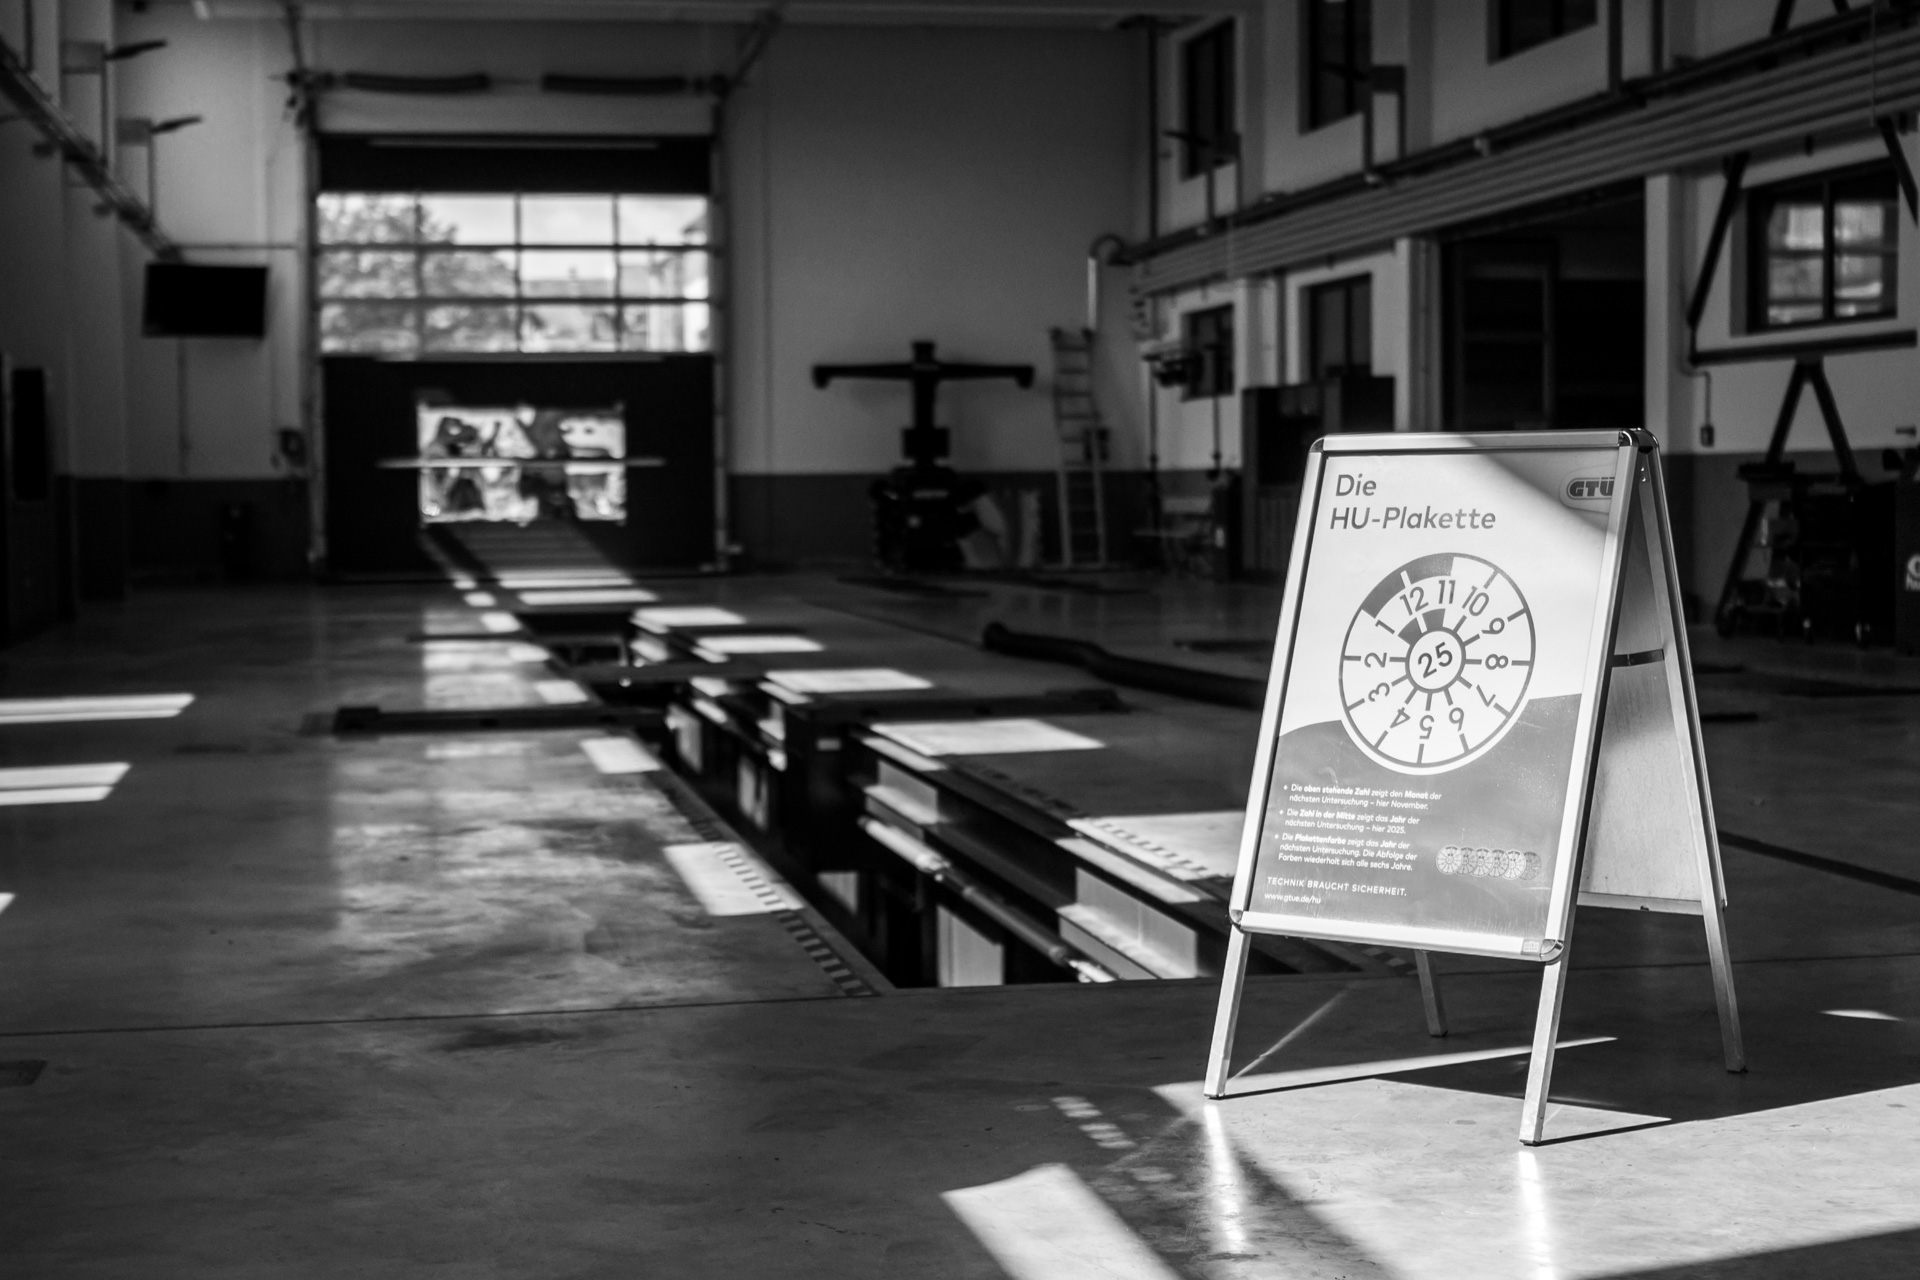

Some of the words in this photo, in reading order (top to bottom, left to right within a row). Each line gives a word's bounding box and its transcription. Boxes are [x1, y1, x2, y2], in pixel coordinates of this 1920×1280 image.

[1335, 473, 1376, 496] Die
[1330, 506, 1496, 530] HU-Plakette
[1399, 586, 1429, 615] 12
[1438, 580, 1456, 604] 11
[1462, 585, 1489, 616] 10
[1375, 619, 1395, 635] 1
[1482, 617, 1505, 635] 9
[1364, 652, 1387, 668] 2
[1418, 642, 1453, 678] 25
[1485, 654, 1508, 670] 8
[1368, 682, 1390, 702] 3
[1476, 684, 1496, 707] 7
[1390, 707, 1411, 728] 4
[1449, 707, 1465, 732] 6
[1419, 715, 1434, 739] 5
[1322, 796, 1368, 807] Untersuchung
[1391, 800, 1428, 809] November.
[1354, 788, 1370, 796] Zahl
[1371, 789, 1388, 798] zeigt
[1405, 790, 1428, 799] Monat
[1317, 821, 1364, 832] Untersuchung
[1387, 826, 1406, 834] 2025.
[1357, 814, 1374, 822] zeigt
[1390, 815, 1406, 823] Jahr
[1295, 834, 1346, 844] Plakettenfarbe
[1347, 838, 1364, 847] zeigt
[1380, 840, 1397, 848] Jahr
[1280, 844, 1310, 852] nächsten
[1312, 846, 1360, 857] Untersuchung.
[1376, 850, 1403, 860] Abfolge
[1278, 853, 1302, 862] Farben
[1304, 856, 1340, 865] wiederholt
[1391, 862, 1412, 871] Jahre.
[1267, 877, 1304, 887] TECHNIK
[1308, 880, 1349, 891] BRAUCHT
[1352, 884, 1406, 896] SICHERHEIT.
[1264, 893, 1321, 904] www.gtue.de/hu
